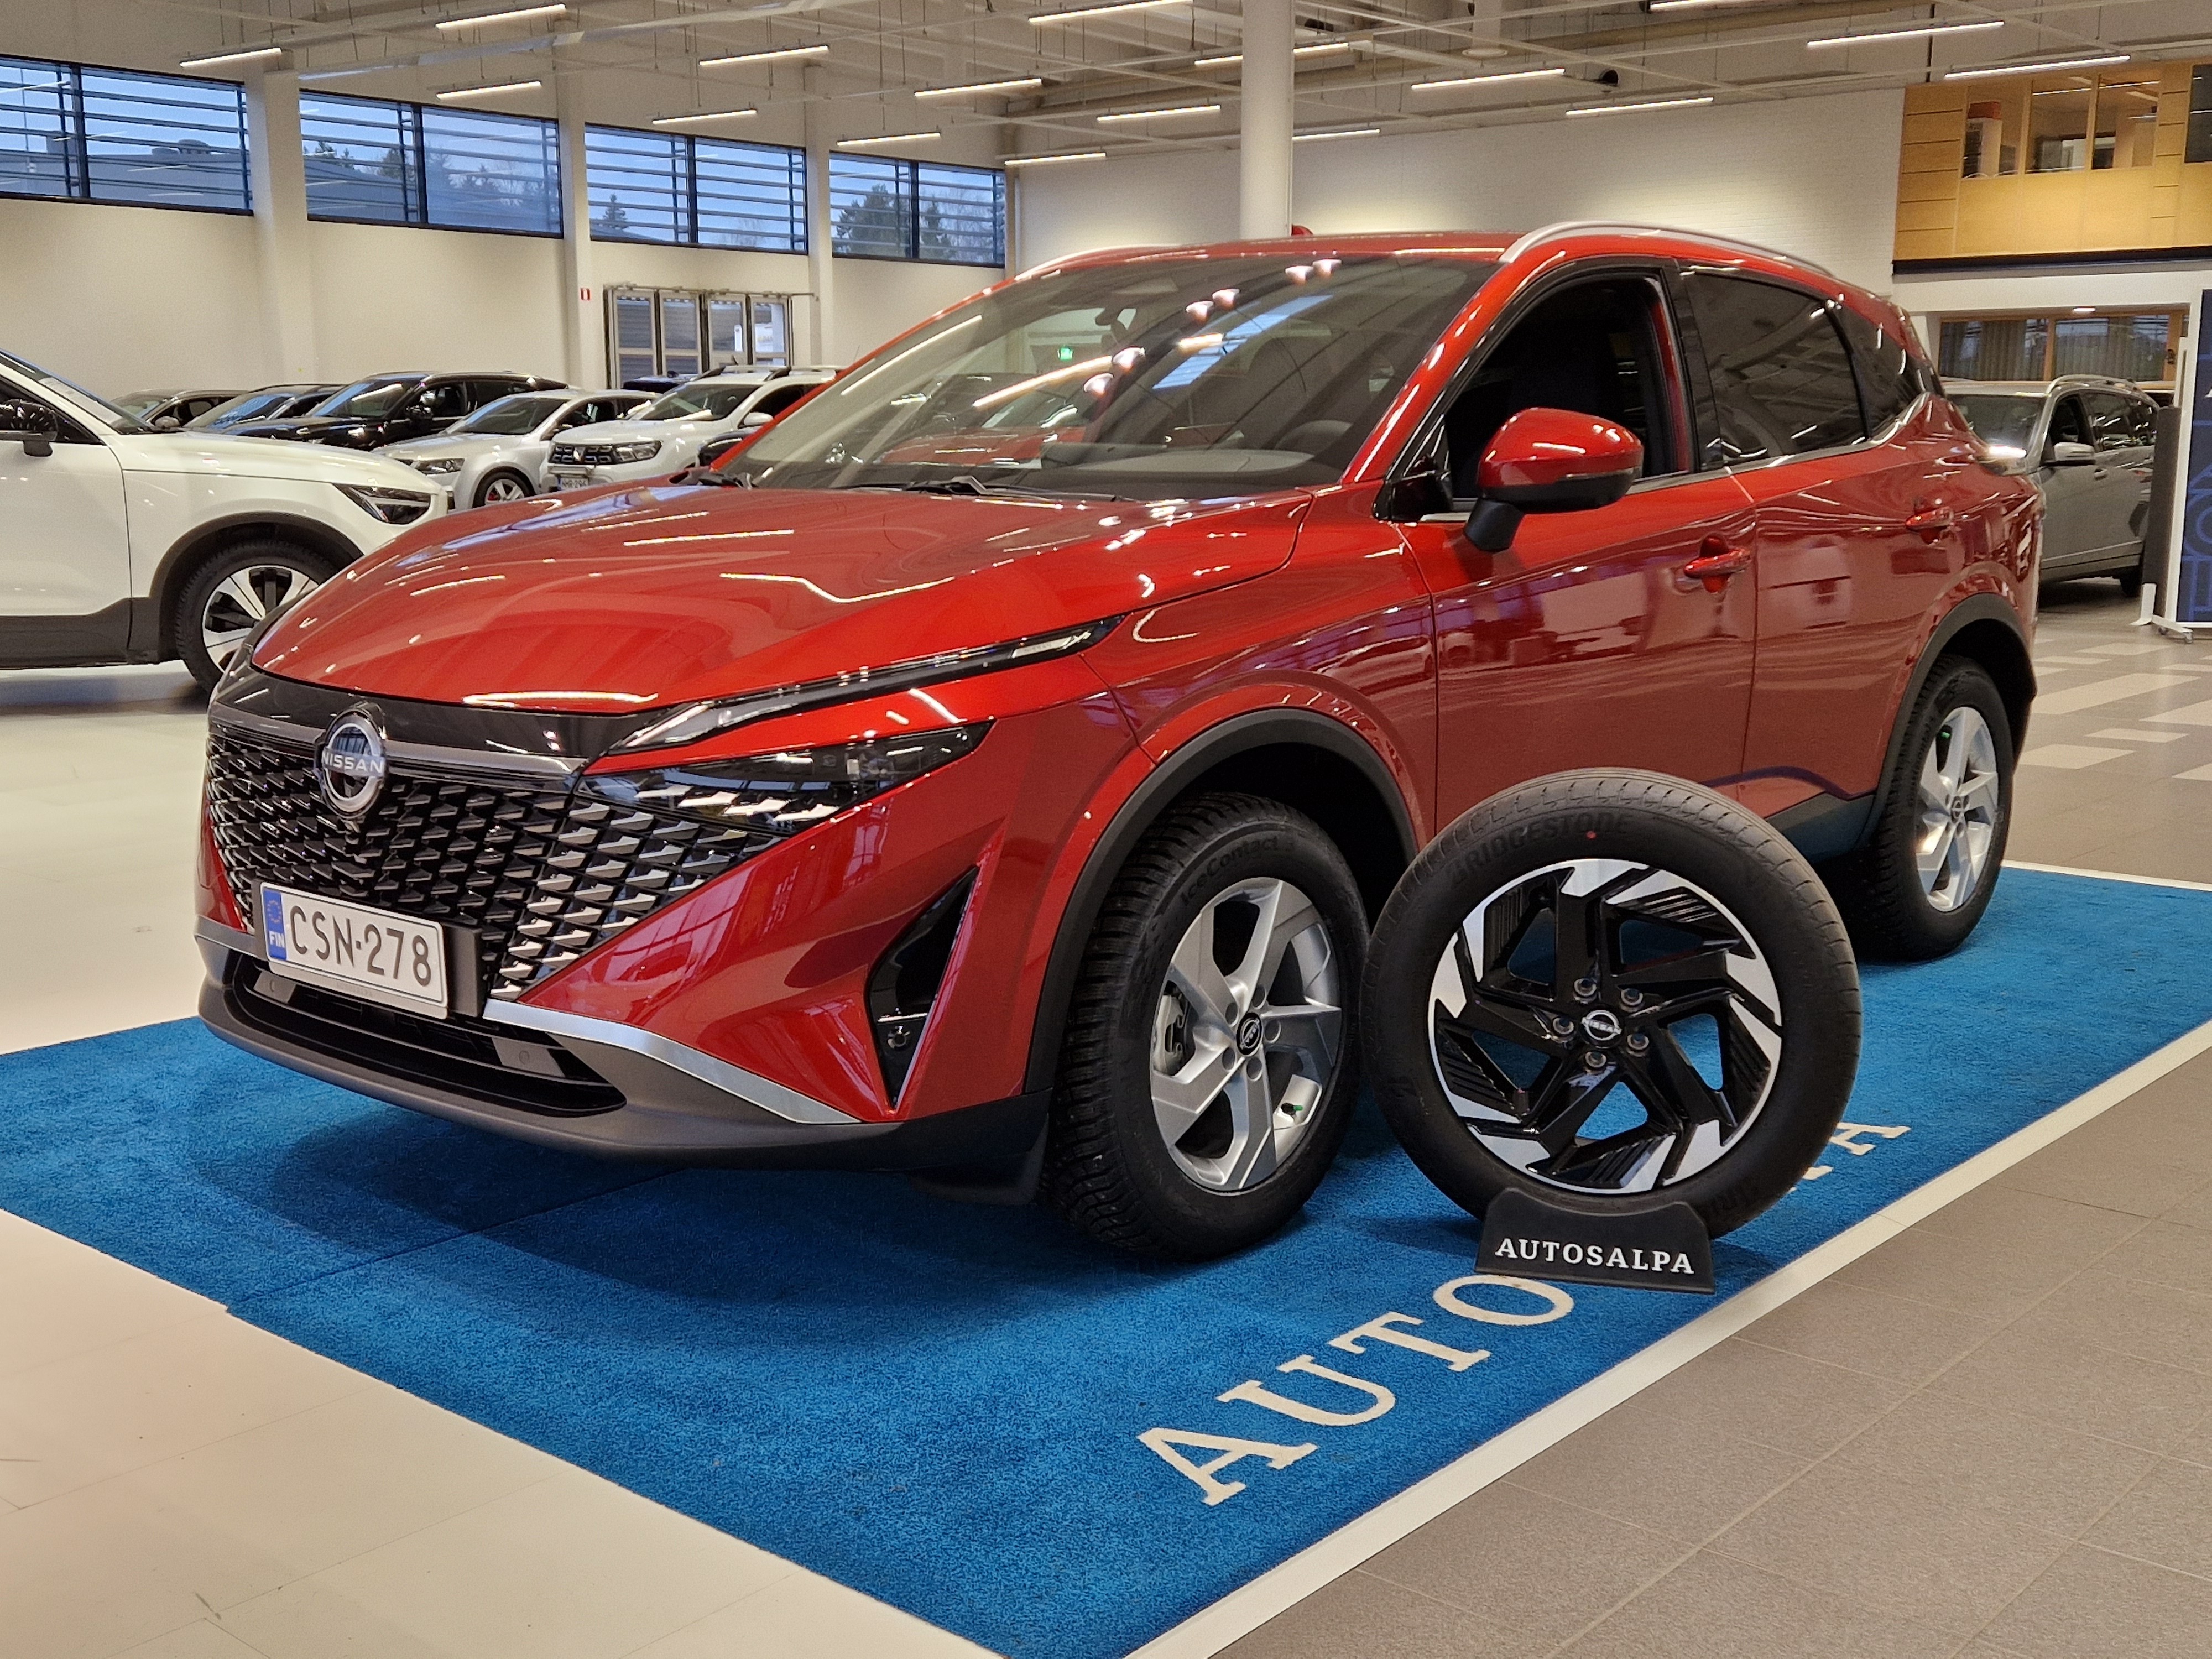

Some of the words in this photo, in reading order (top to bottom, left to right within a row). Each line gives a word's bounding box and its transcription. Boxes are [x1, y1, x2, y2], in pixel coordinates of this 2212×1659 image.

[321, 751, 385, 774] NISSAN
[269, 932, 285, 948] FIN
[290, 906, 431, 987] CSN-278
[1495, 1238, 1694, 1274] AUTOSALPA
